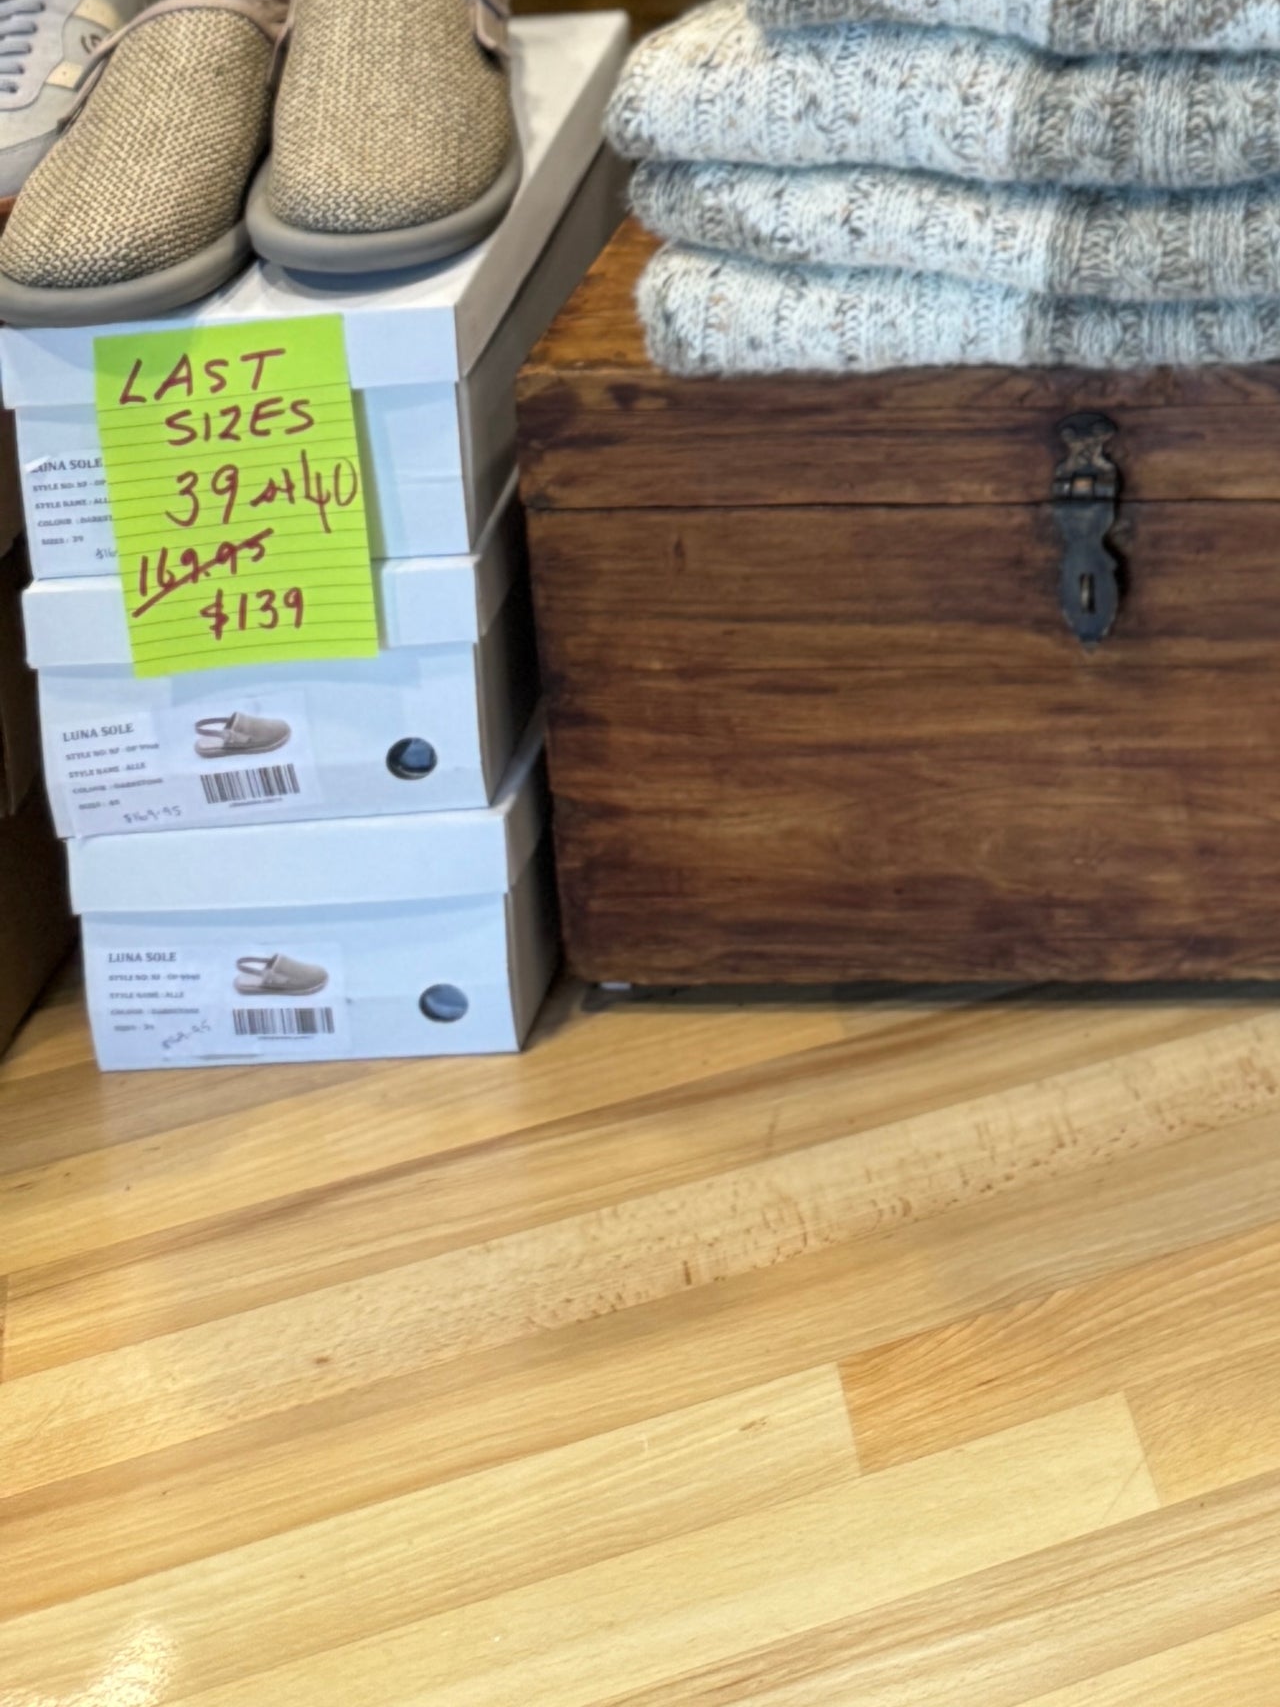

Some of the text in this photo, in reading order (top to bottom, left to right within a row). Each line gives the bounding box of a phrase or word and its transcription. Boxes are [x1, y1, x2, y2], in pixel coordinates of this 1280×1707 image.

[119, 347, 286, 406] LAST
[164, 396, 315, 446] SIZES
[30, 458, 104, 473] UNA SOLE
[164, 464, 239, 527] 39
[299, 448, 358, 534] 40
[199, 587, 305, 641] $139
[62, 723, 134, 742] LUNA SOLE
[108, 952, 177, 963] LUNA SOLE
